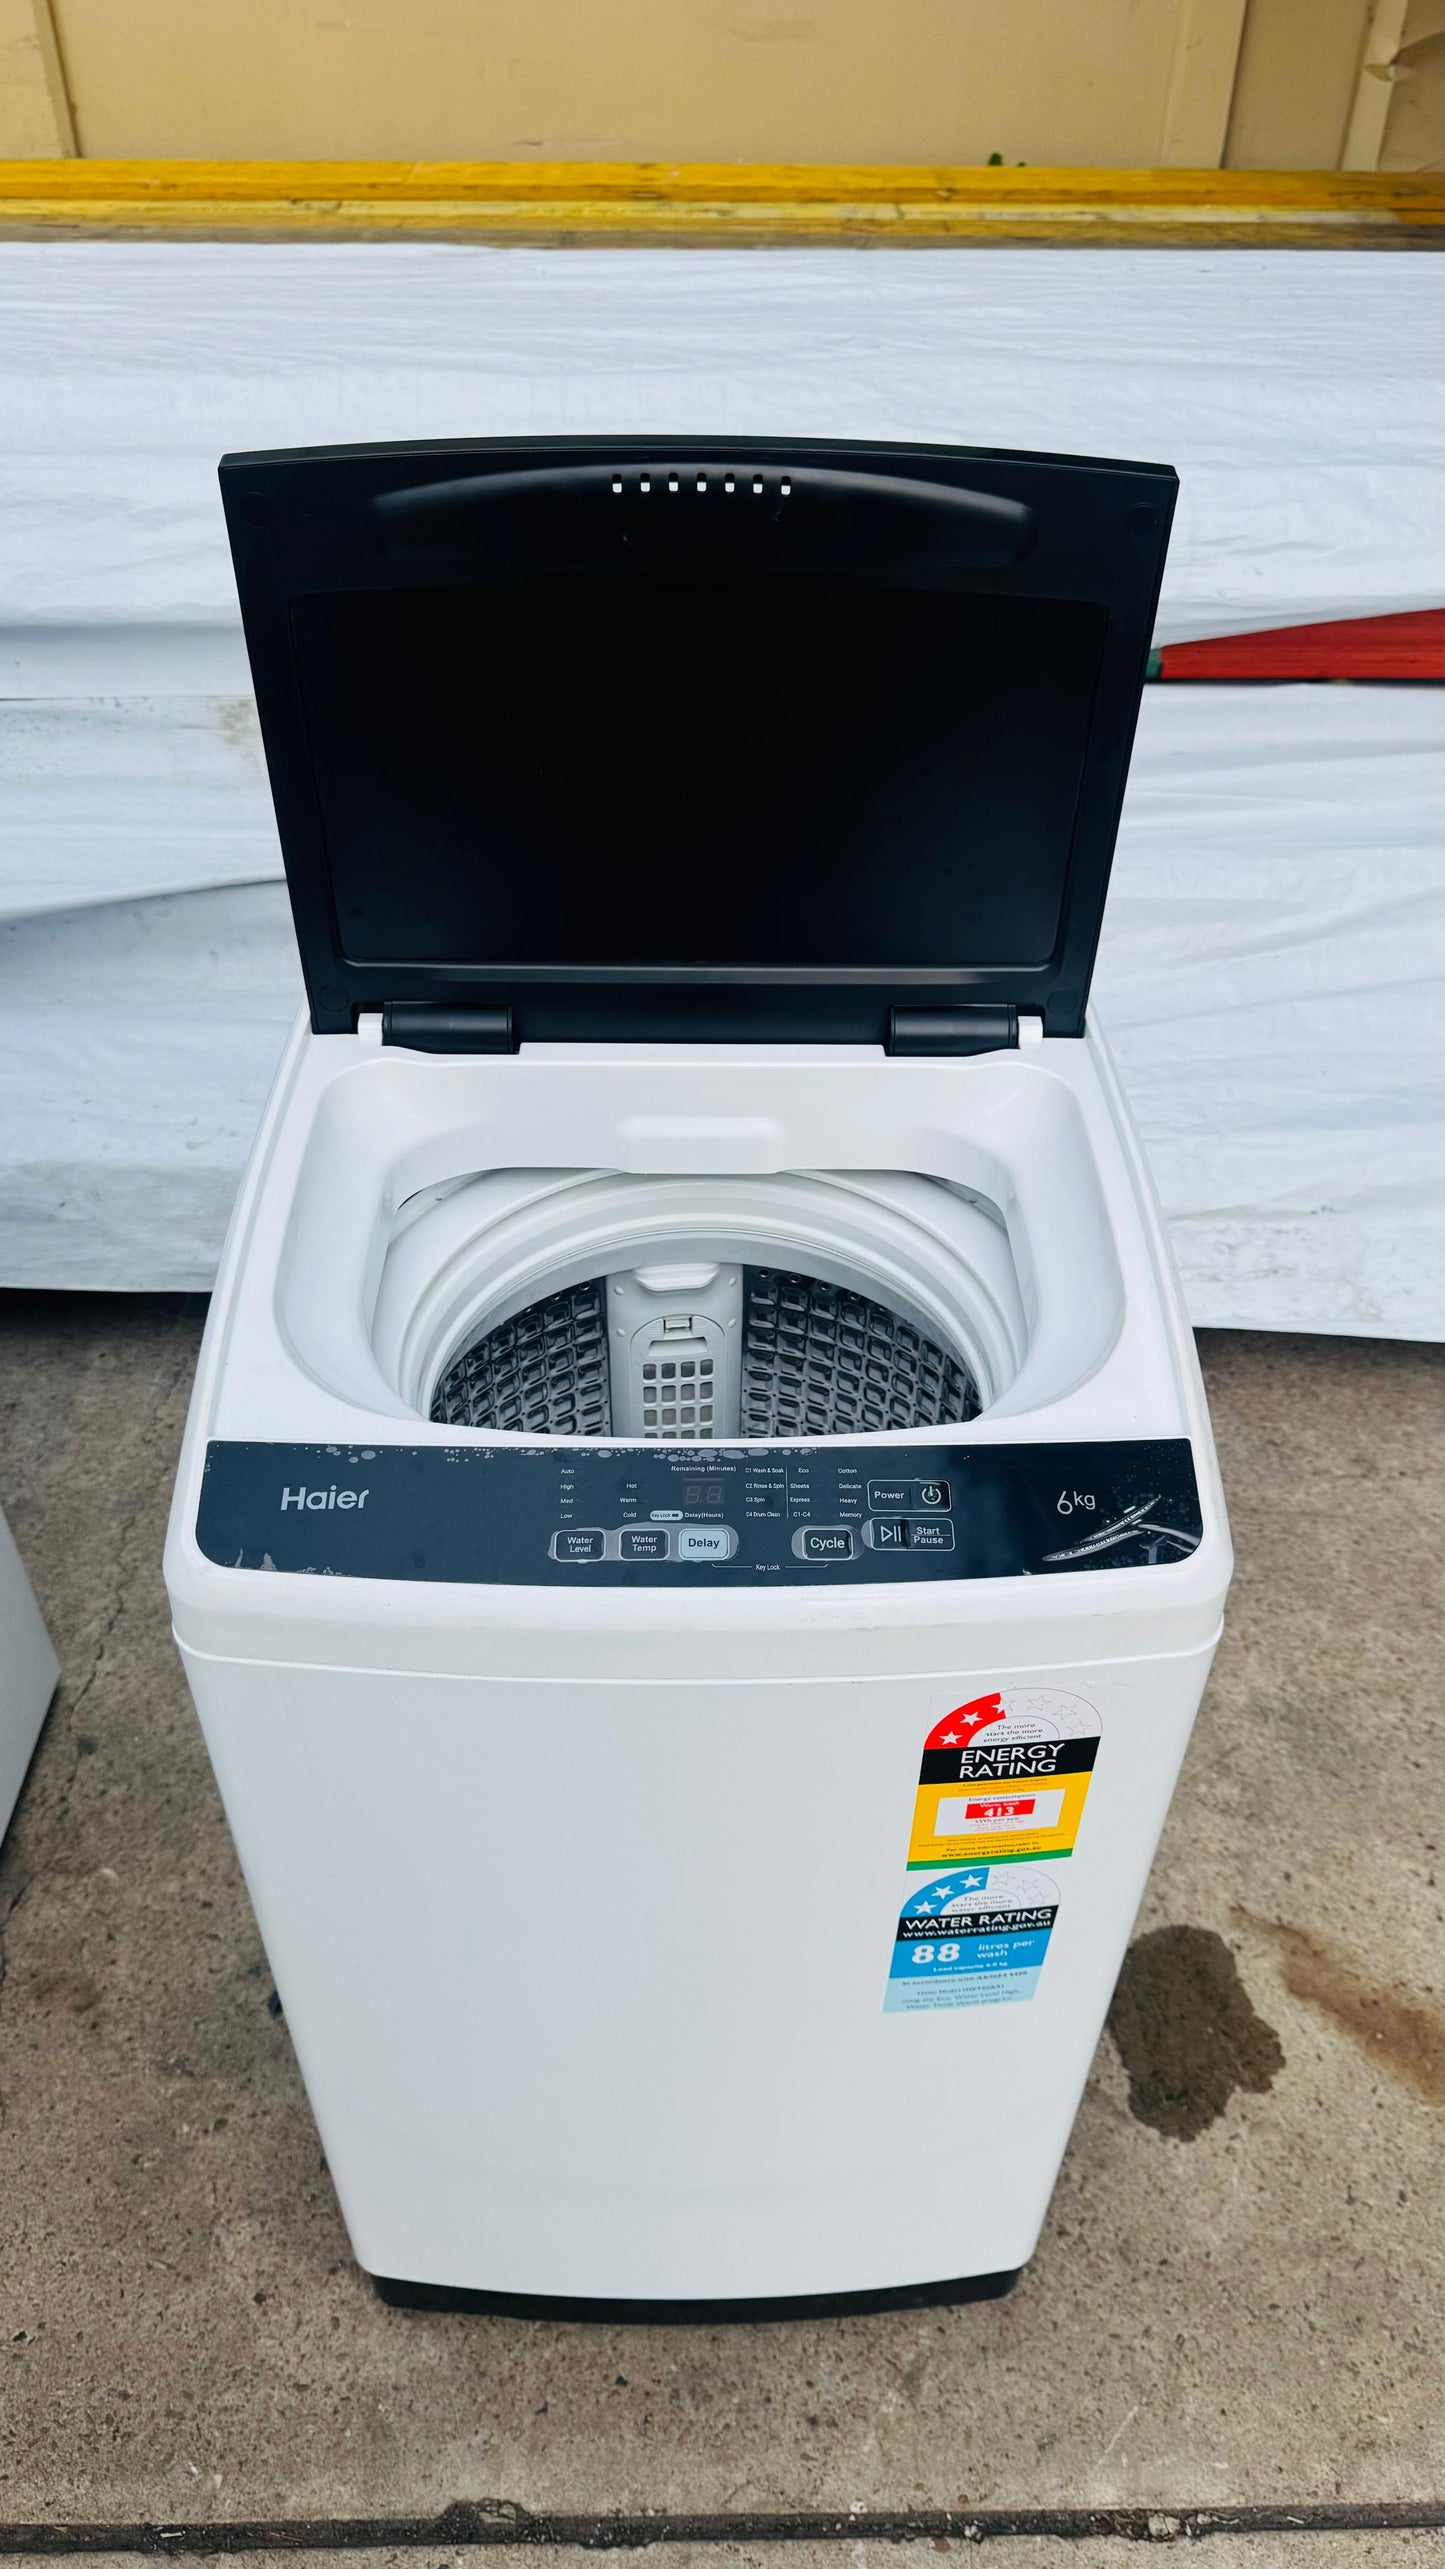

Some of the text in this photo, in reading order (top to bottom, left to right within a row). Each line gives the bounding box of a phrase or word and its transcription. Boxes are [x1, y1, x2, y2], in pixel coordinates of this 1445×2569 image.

[280, 1484, 370, 1512] Haier
[874, 1491, 905, 1499] Power
[916, 1527, 940, 1535] Start
[567, 1537, 594, 1545] Water
[688, 1539, 720, 1549] Delay
[810, 1537, 845, 1551] Cycle
[914, 1536, 944, 1544] Pause
[570, 1545, 592, 1553] Level
[633, 1544, 657, 1553] Temp
[961, 1743, 1066, 1764] ENERGY
[959, 1760, 1057, 1779] RATING
[984, 1807, 1014, 1817] 413
[905, 1909, 1052, 1929] WATER RATING
[979, 1940, 1035, 1951] litres per
[911, 1943, 961, 1964] 88
[976, 1949, 1008, 1959] wash
